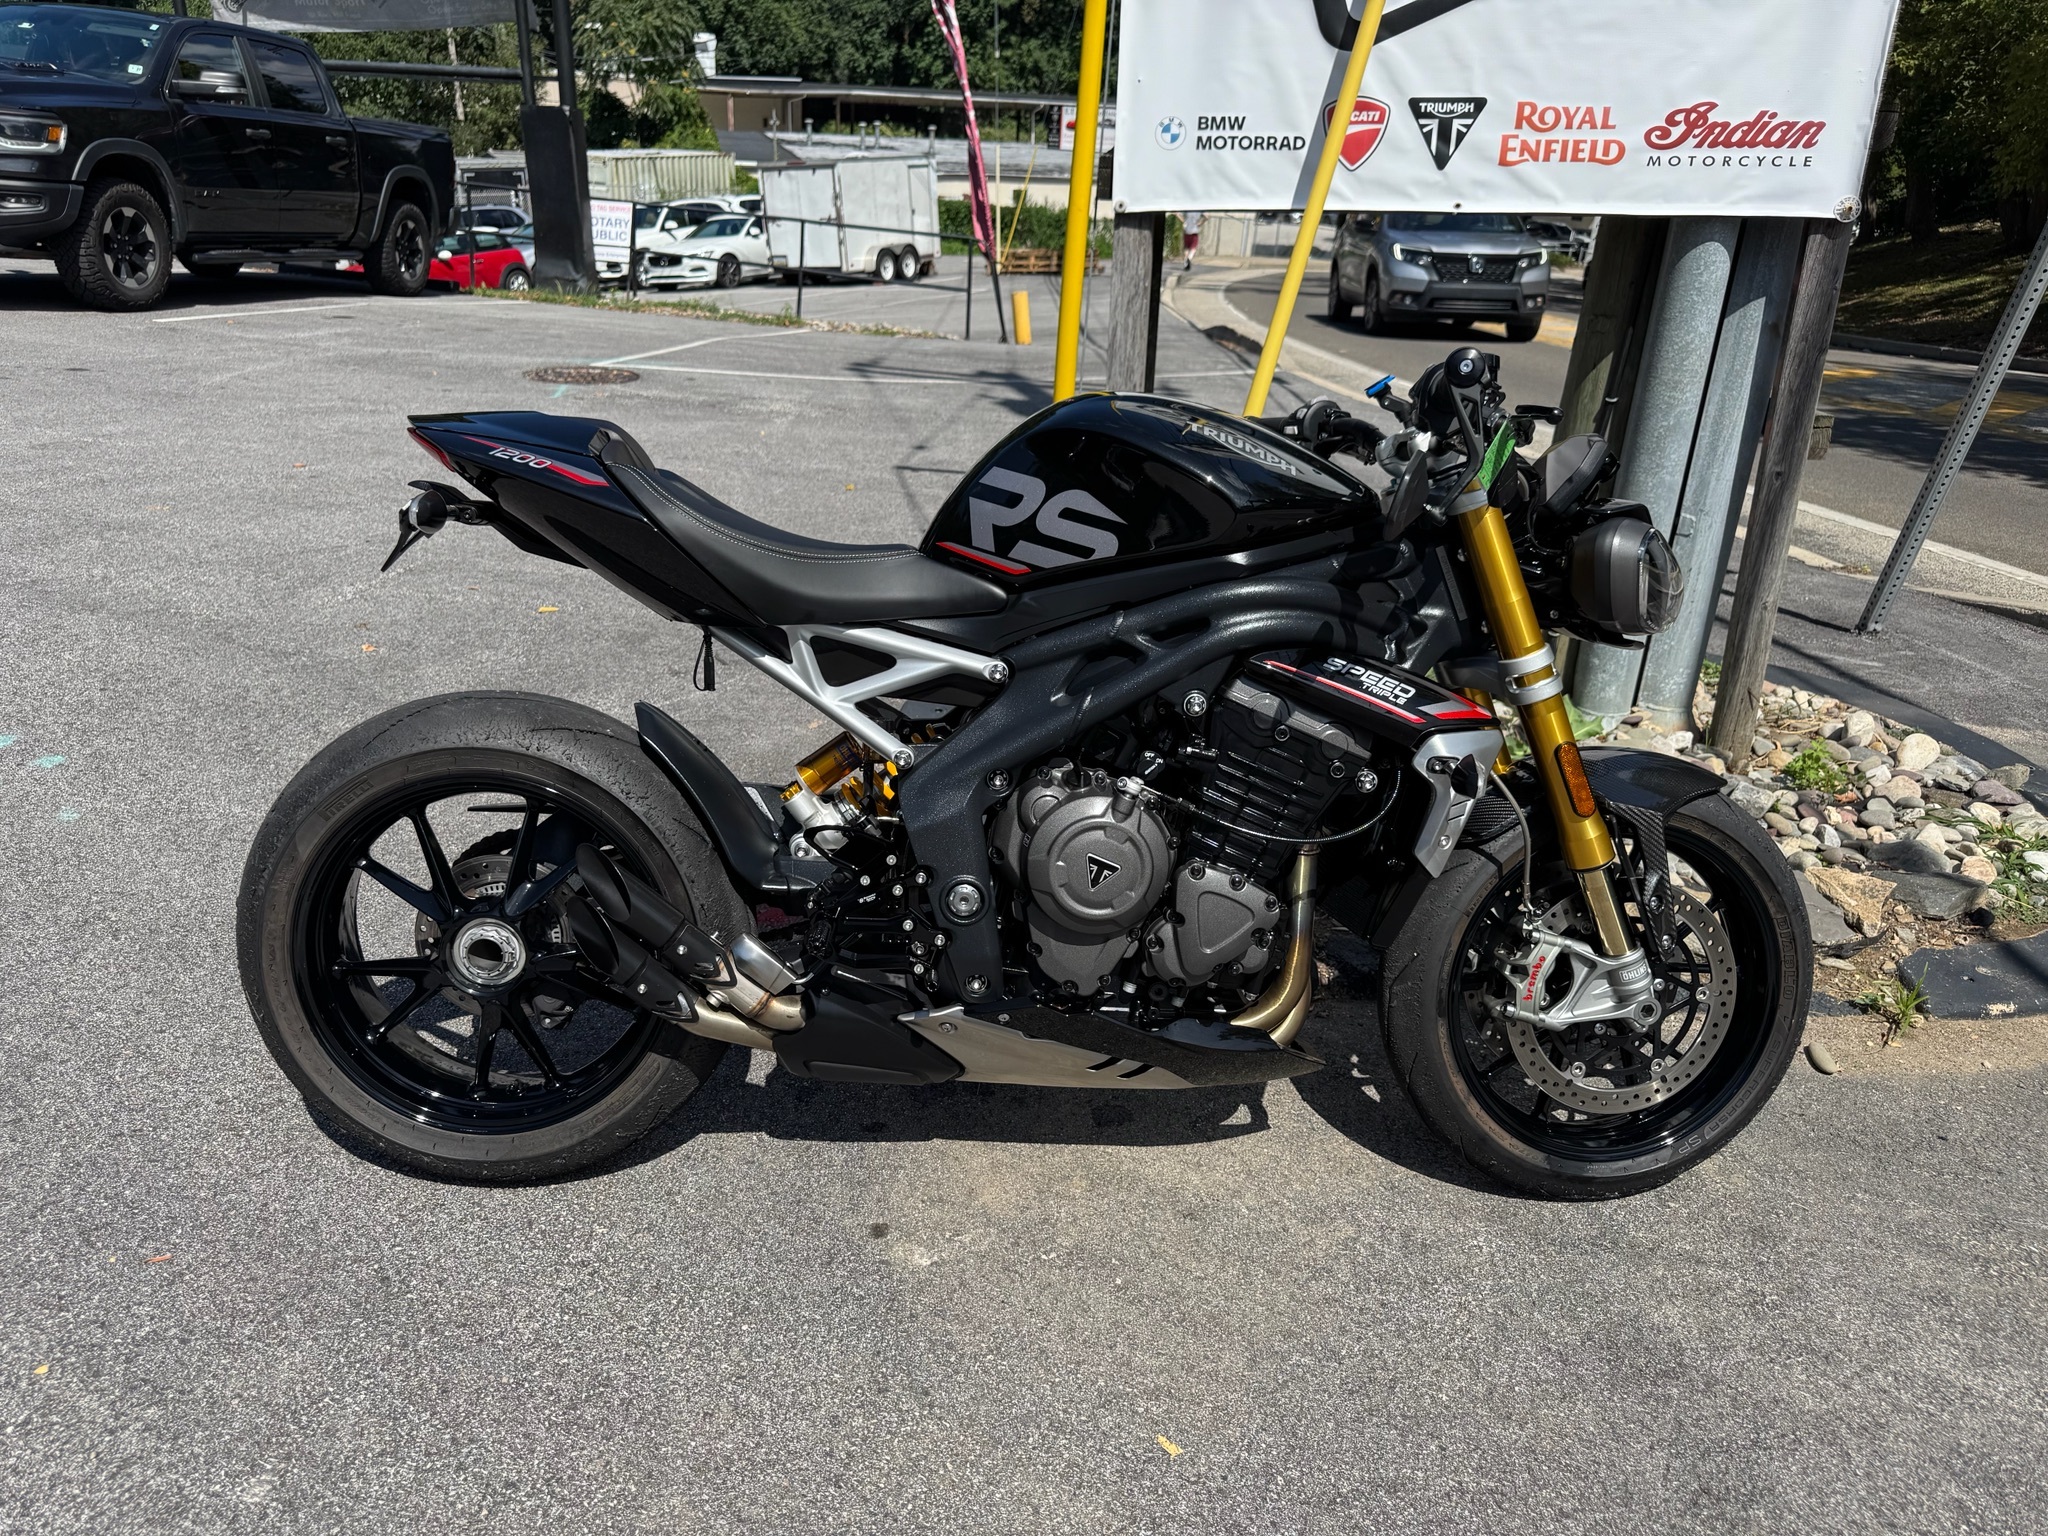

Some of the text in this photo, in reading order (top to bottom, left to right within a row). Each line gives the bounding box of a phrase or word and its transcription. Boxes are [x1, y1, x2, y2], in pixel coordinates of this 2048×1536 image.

[1350, 110, 1381, 122] CATI
[1419, 102, 1475, 117] TRIUMPH
[1514, 101, 1617, 133] ROYAL
[1197, 116, 1246, 131] BMW
[1643, 101, 1827, 150] Indian
[1195, 136, 1306, 151] MOTORRAD
[1497, 134, 1626, 167] ENFIELD
[1646, 155, 1813, 167] MOTORCYCLE
[591, 217, 630, 229] OTARY
[592, 229, 628, 242] UBLIC
[489, 447, 552, 468] 1200
[1186, 420, 1297, 476] TRIUMPH
[969, 466, 1129, 569] RS
[1322, 657, 1417, 699] SPEED
[1361, 682, 1408, 705] TRIPLE
[317, 775, 375, 822] PIRELLI
[1773, 915, 1799, 1001] DIABLO
[1522, 955, 1547, 1002] brembo
[1621, 962, 1648, 982] ÖHLINS
[1678, 1037, 1784, 1155] SUPERCORSA SP
